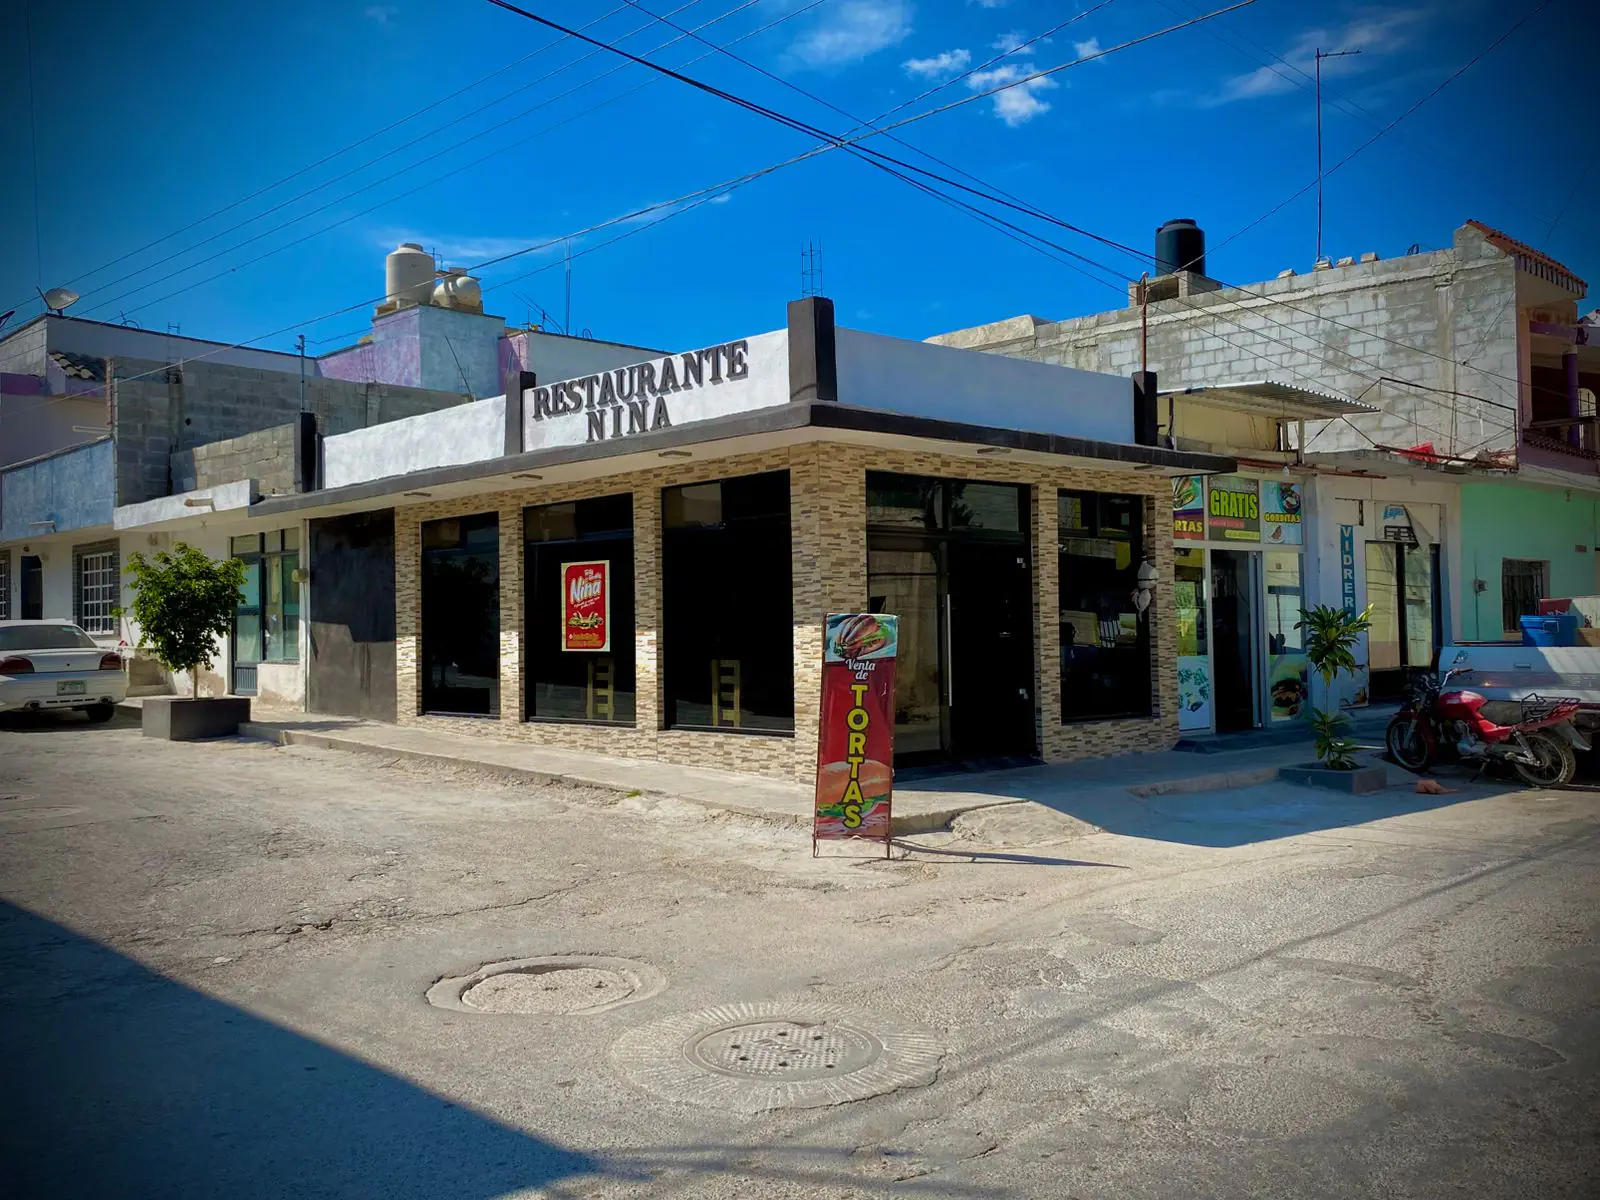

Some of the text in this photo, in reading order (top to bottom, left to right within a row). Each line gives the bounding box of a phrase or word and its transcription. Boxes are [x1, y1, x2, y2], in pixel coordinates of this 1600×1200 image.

[533, 340, 748, 421] RESTAURANTE
[585, 397, 672, 443] NINA
[1210, 489, 1258, 520] GRATIS
[570, 576, 602, 604] Nina
[845, 658, 876, 671] Venta
[855, 669, 869, 680] de
[844, 684, 869, 828] TORTAS
